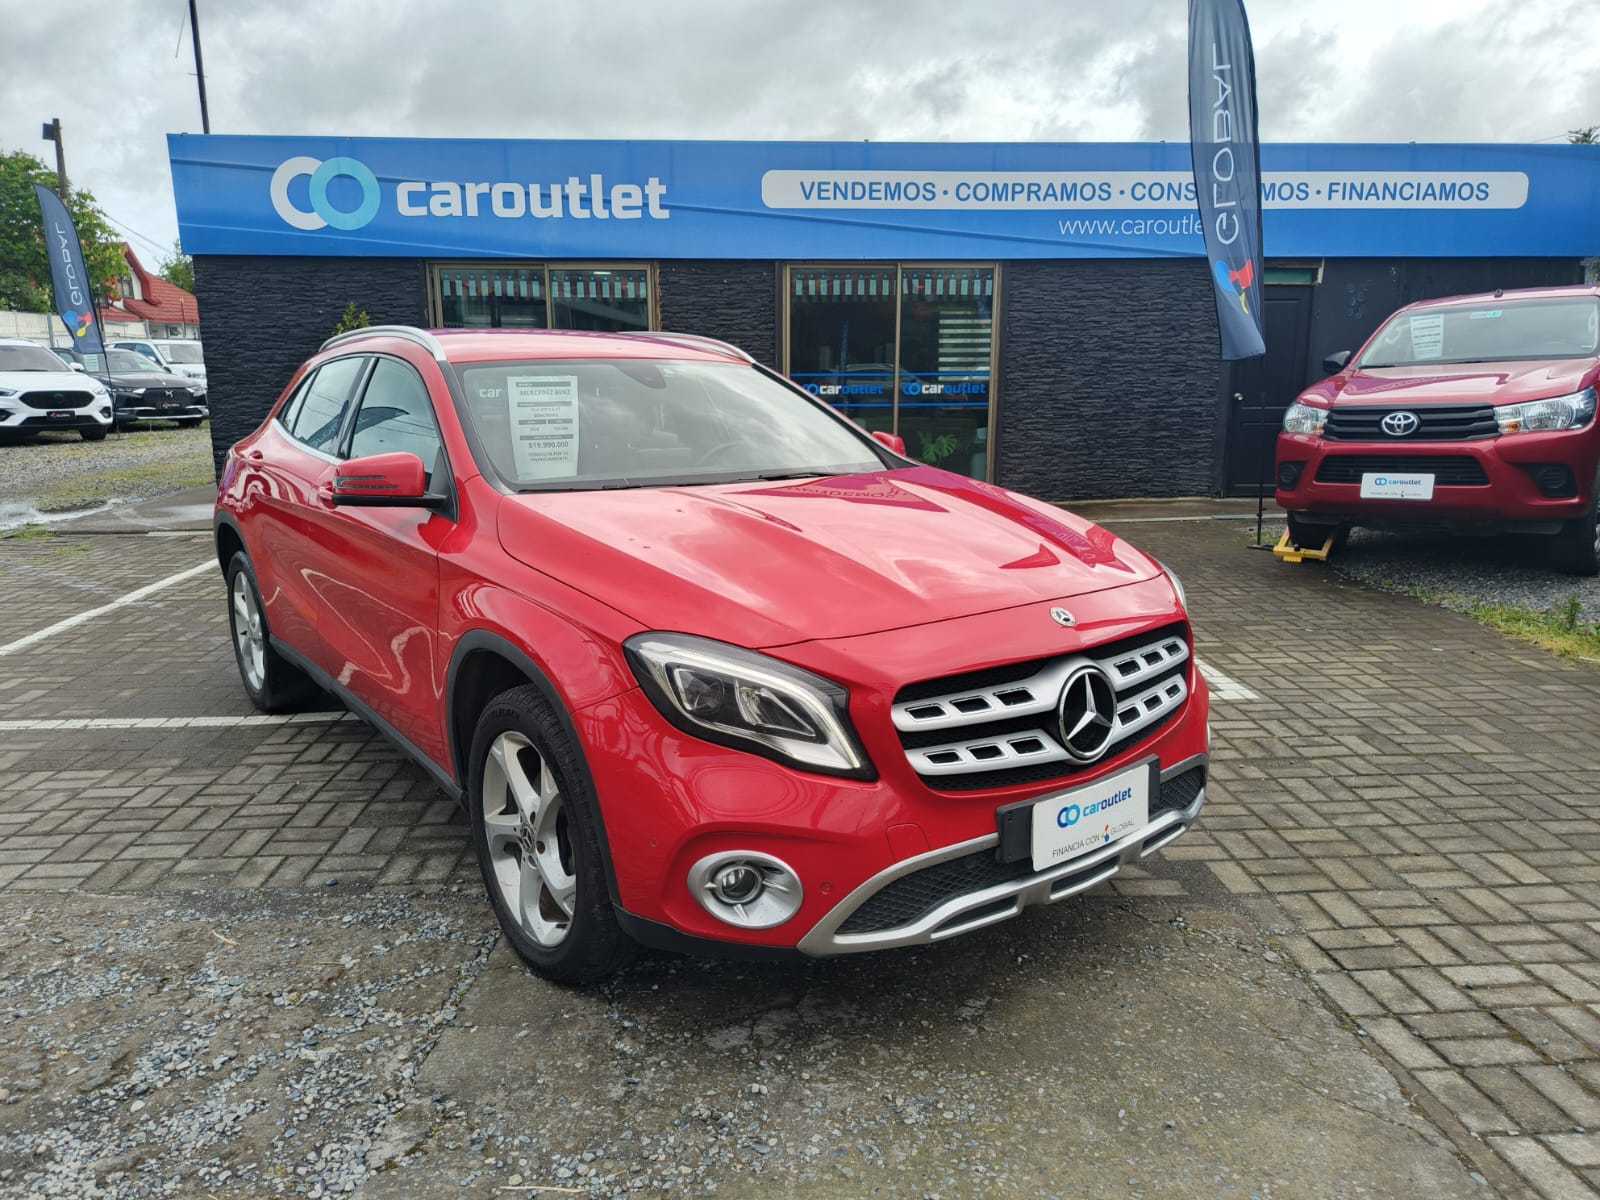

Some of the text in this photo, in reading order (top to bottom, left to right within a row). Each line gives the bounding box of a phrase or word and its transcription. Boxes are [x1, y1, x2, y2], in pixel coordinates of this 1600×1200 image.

[396, 173, 671, 220] caroutlet
[799, 180, 937, 201] VENDEMOS
[954, 181, 1113, 202] COMPRAMOS
[1327, 181, 1491, 202] FINANCIAMOS
[1058, 213, 1204, 235] www.caroutle
[819, 383, 884, 396] caroutlet
[921, 381, 987, 396] caroutlet
[1082, 787, 1132, 817] caroutlet
[1052, 818, 1135, 858] FINANCIA CON GLOBAL
